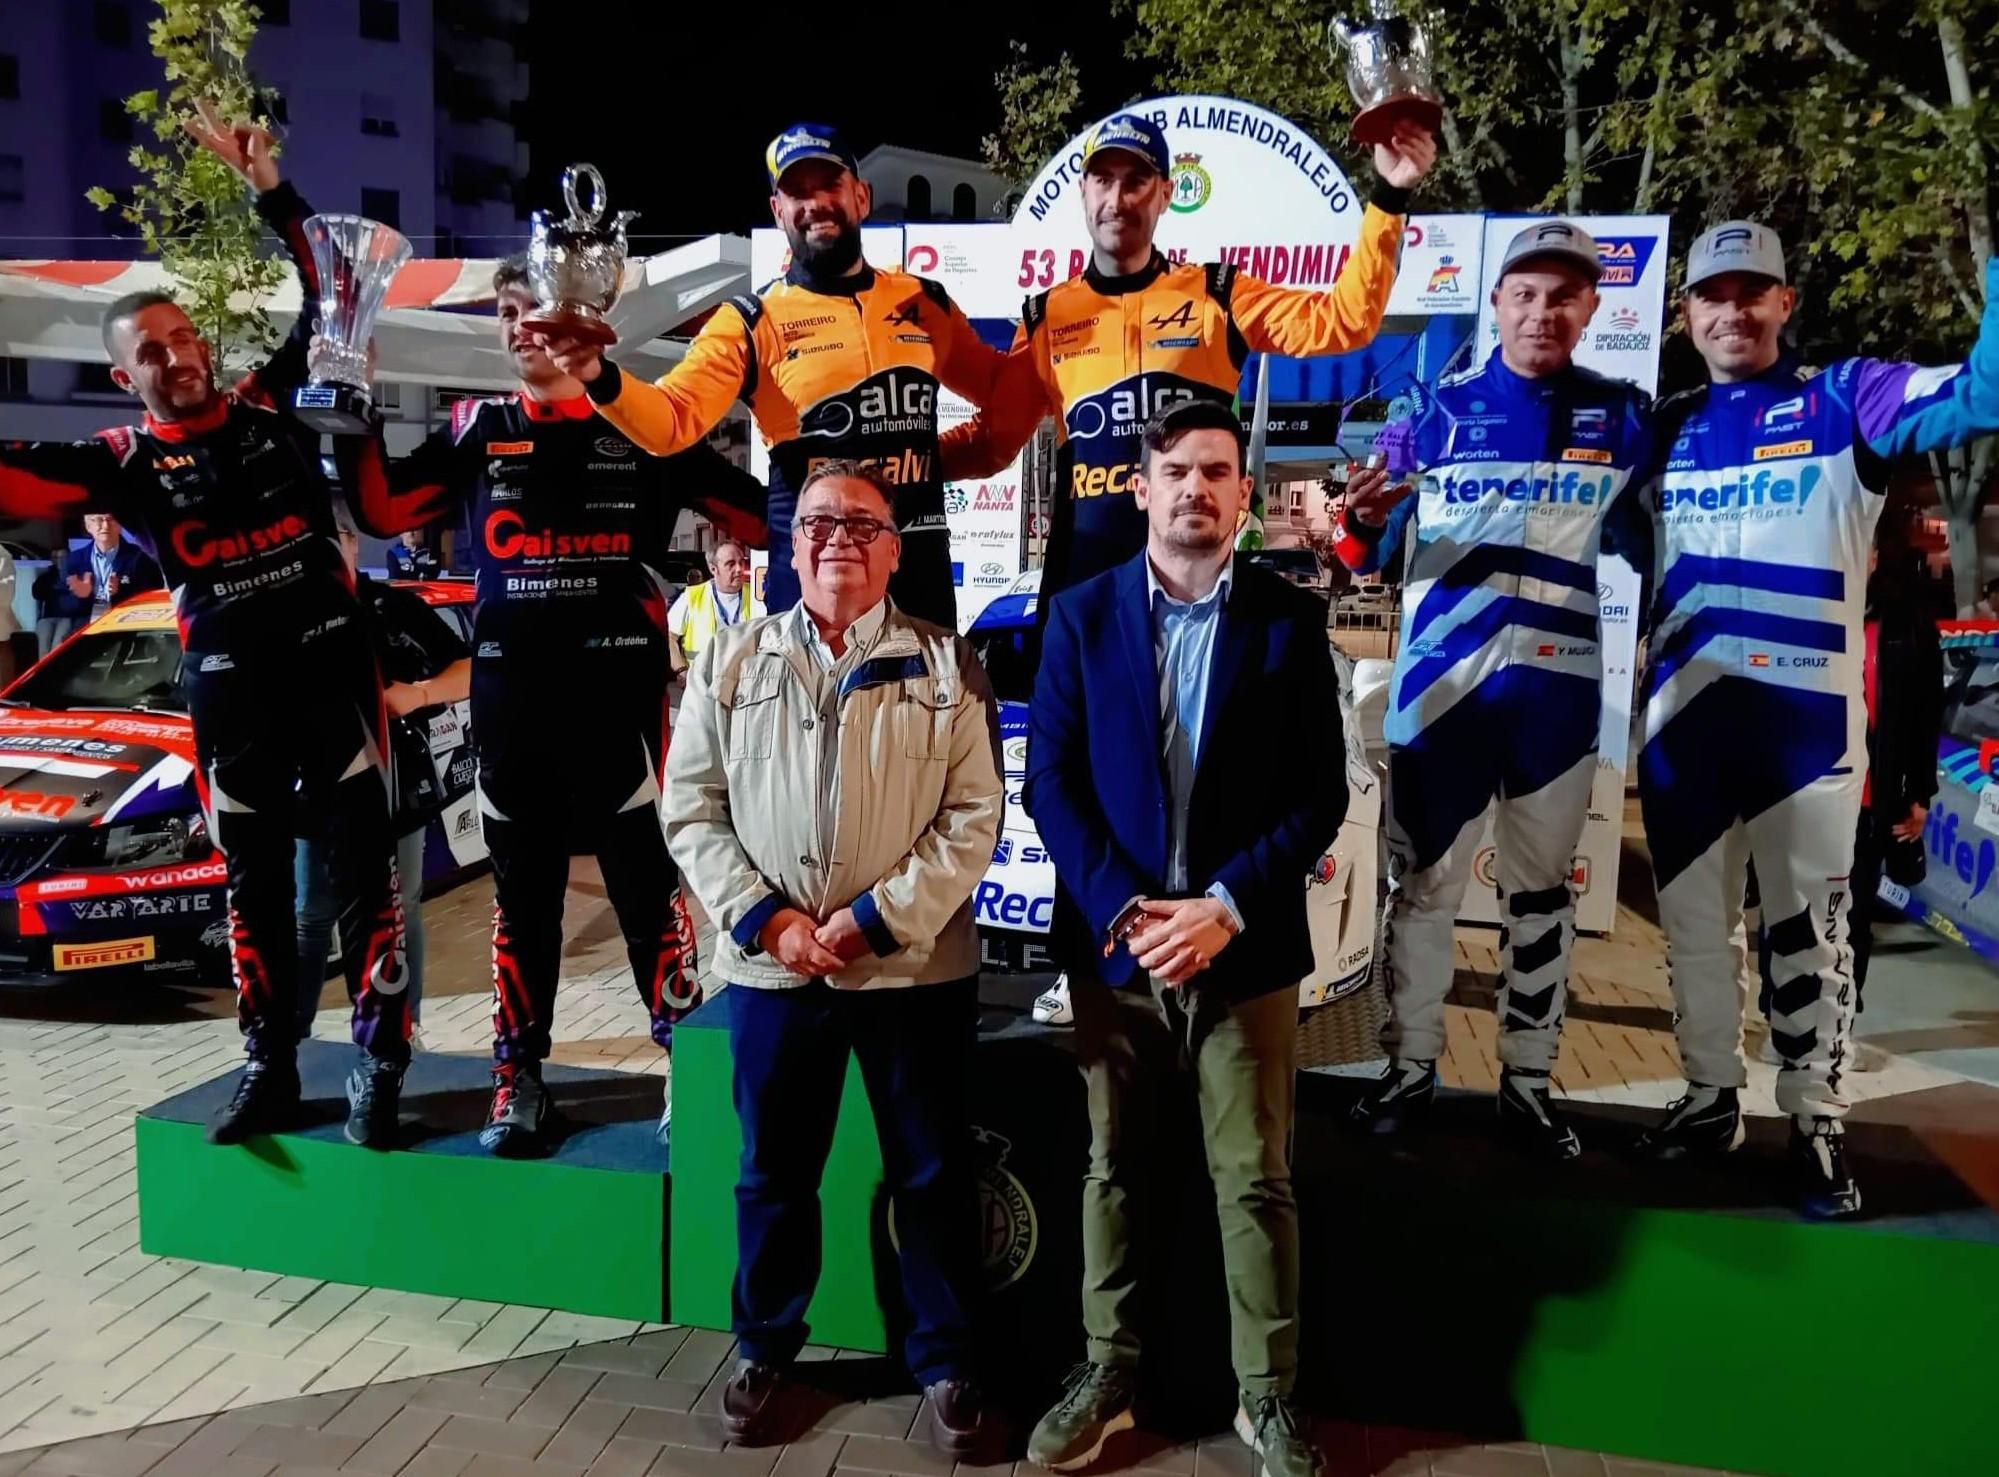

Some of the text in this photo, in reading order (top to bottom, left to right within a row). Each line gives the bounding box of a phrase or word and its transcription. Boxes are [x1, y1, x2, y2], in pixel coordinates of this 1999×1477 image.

[1177, 106, 1349, 215] ALMENDRALEJO
[1018, 249, 1056, 288] 53
[780, 315, 837, 331] TORREIRO
[1052, 317, 1099, 337] TORREIRO
[859, 374, 933, 417] alca
[1111, 378, 1194, 421] alc
[861, 416, 931, 434] automóviles
[1112, 421, 1146, 437] auto
[1453, 450, 1500, 460] worten
[1667, 459, 1695, 470] orten
[1658, 464, 1821, 516] enerife!
[973, 502, 1014, 511] NANTA
[485, 510, 631, 559] Gaisven
[212, 560, 304, 597] Bimenes
[506, 577, 598, 592] Bimenes
[1777, 656, 1829, 668] E. CRUZ
[62, 942, 145, 966] PIRELLI
